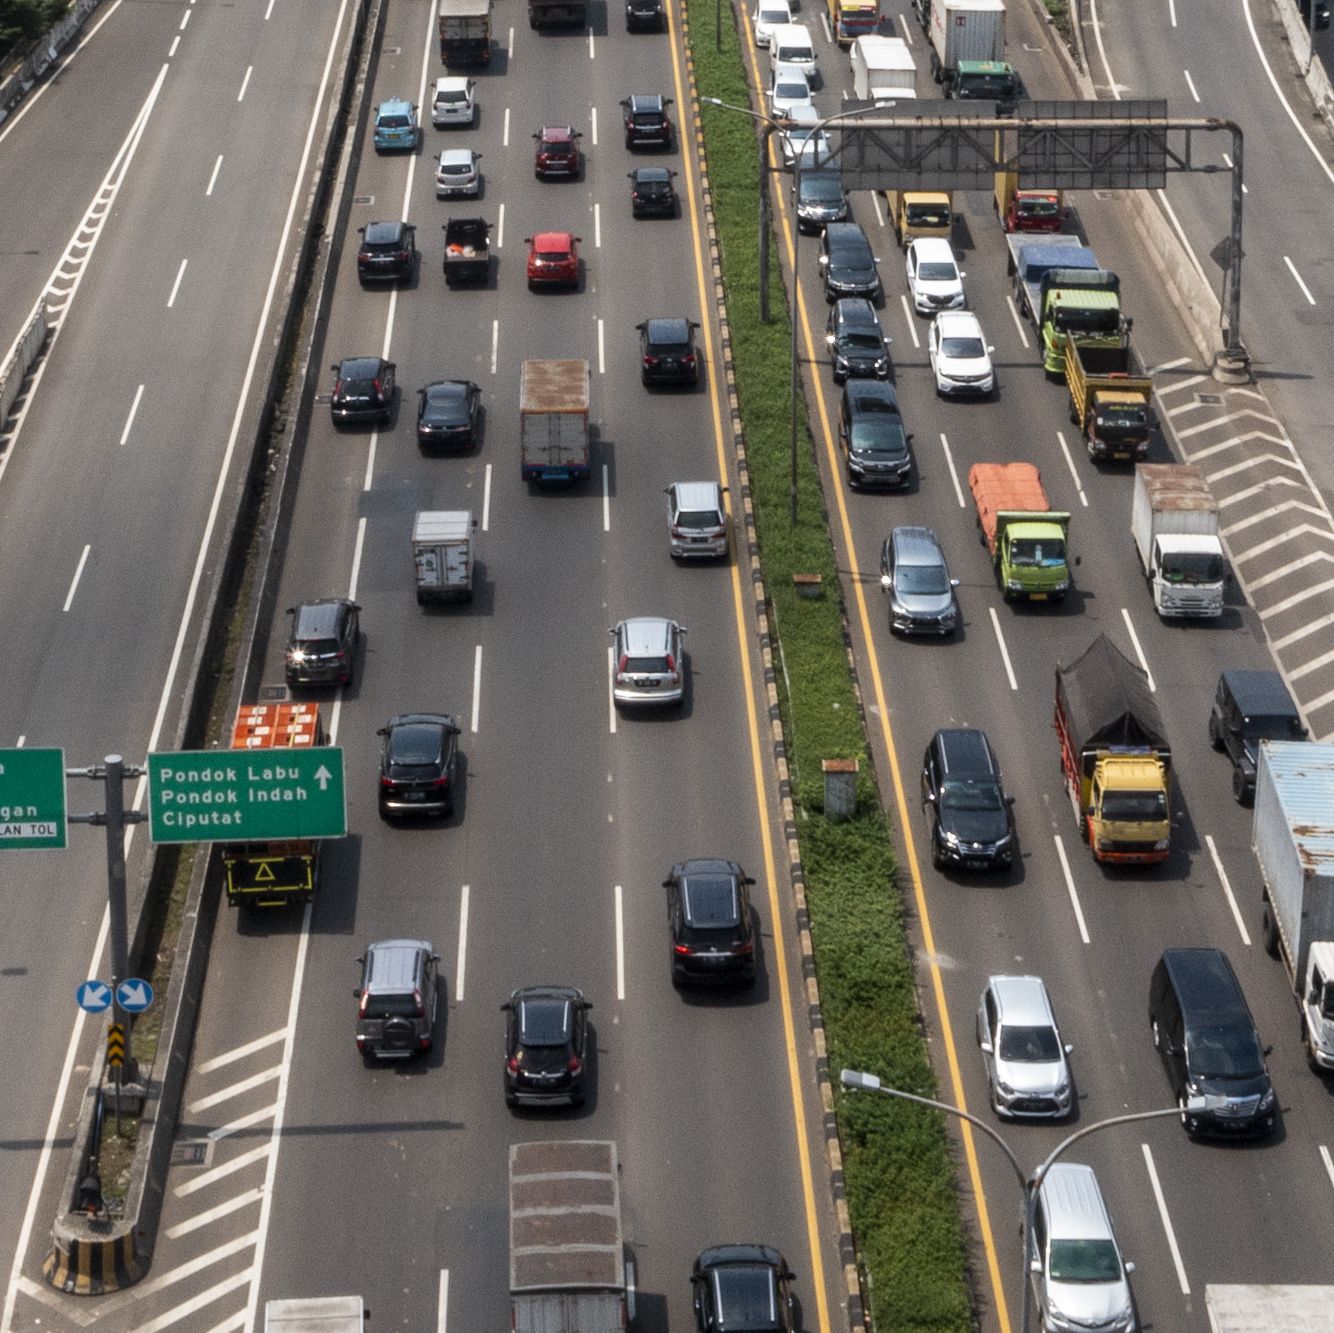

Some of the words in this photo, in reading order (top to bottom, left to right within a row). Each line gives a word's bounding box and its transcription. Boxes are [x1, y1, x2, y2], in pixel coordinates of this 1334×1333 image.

[160, 767, 237, 782] Pondok
[248, 766, 299, 781] Labu
[161, 789, 238, 804] Pondok
[249, 787, 307, 802] Indah
[162, 810, 242, 827] Ciputat
[31, 824, 55, 835] TOL
